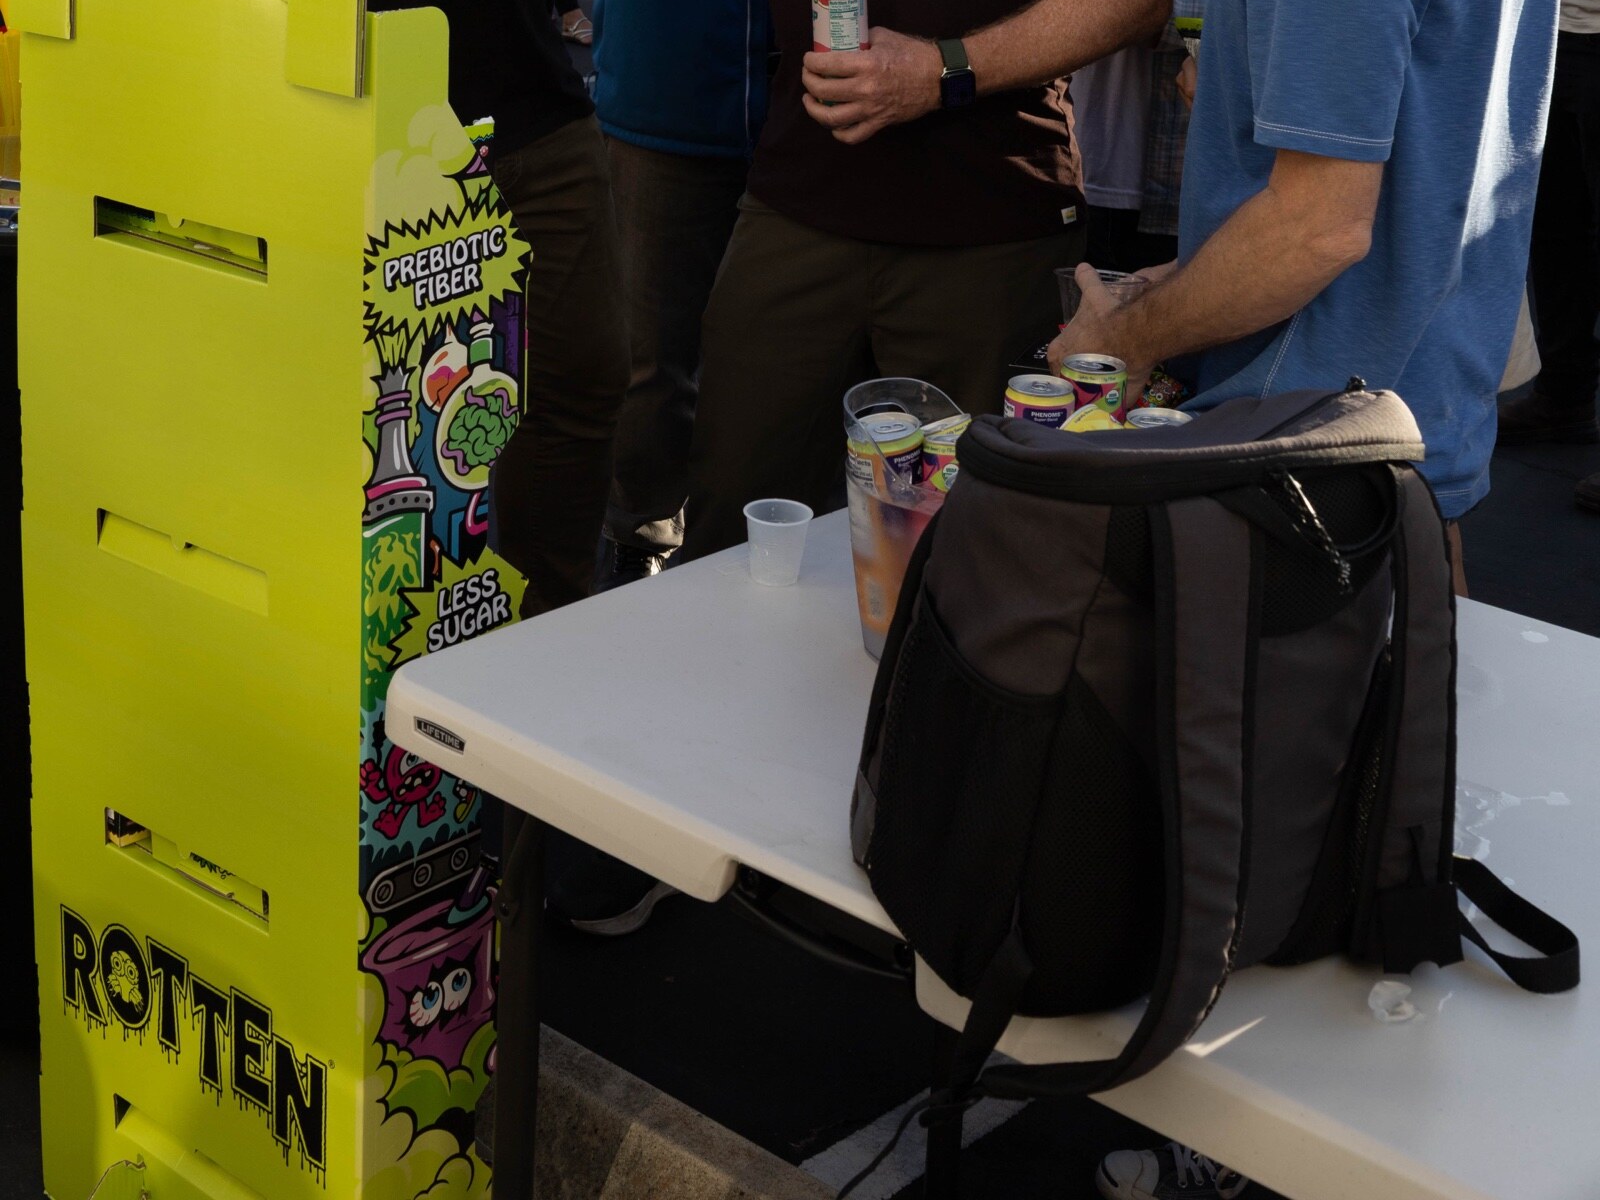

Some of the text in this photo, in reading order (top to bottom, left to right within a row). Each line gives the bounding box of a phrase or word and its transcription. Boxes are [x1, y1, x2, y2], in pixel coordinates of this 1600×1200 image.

[384, 226, 504, 288] PREBIOTIC
[414, 262, 480, 307] FIBER
[438, 569, 497, 618] LESS
[427, 593, 509, 652] SUGAR
[421, 721, 460, 749] LIFETIME
